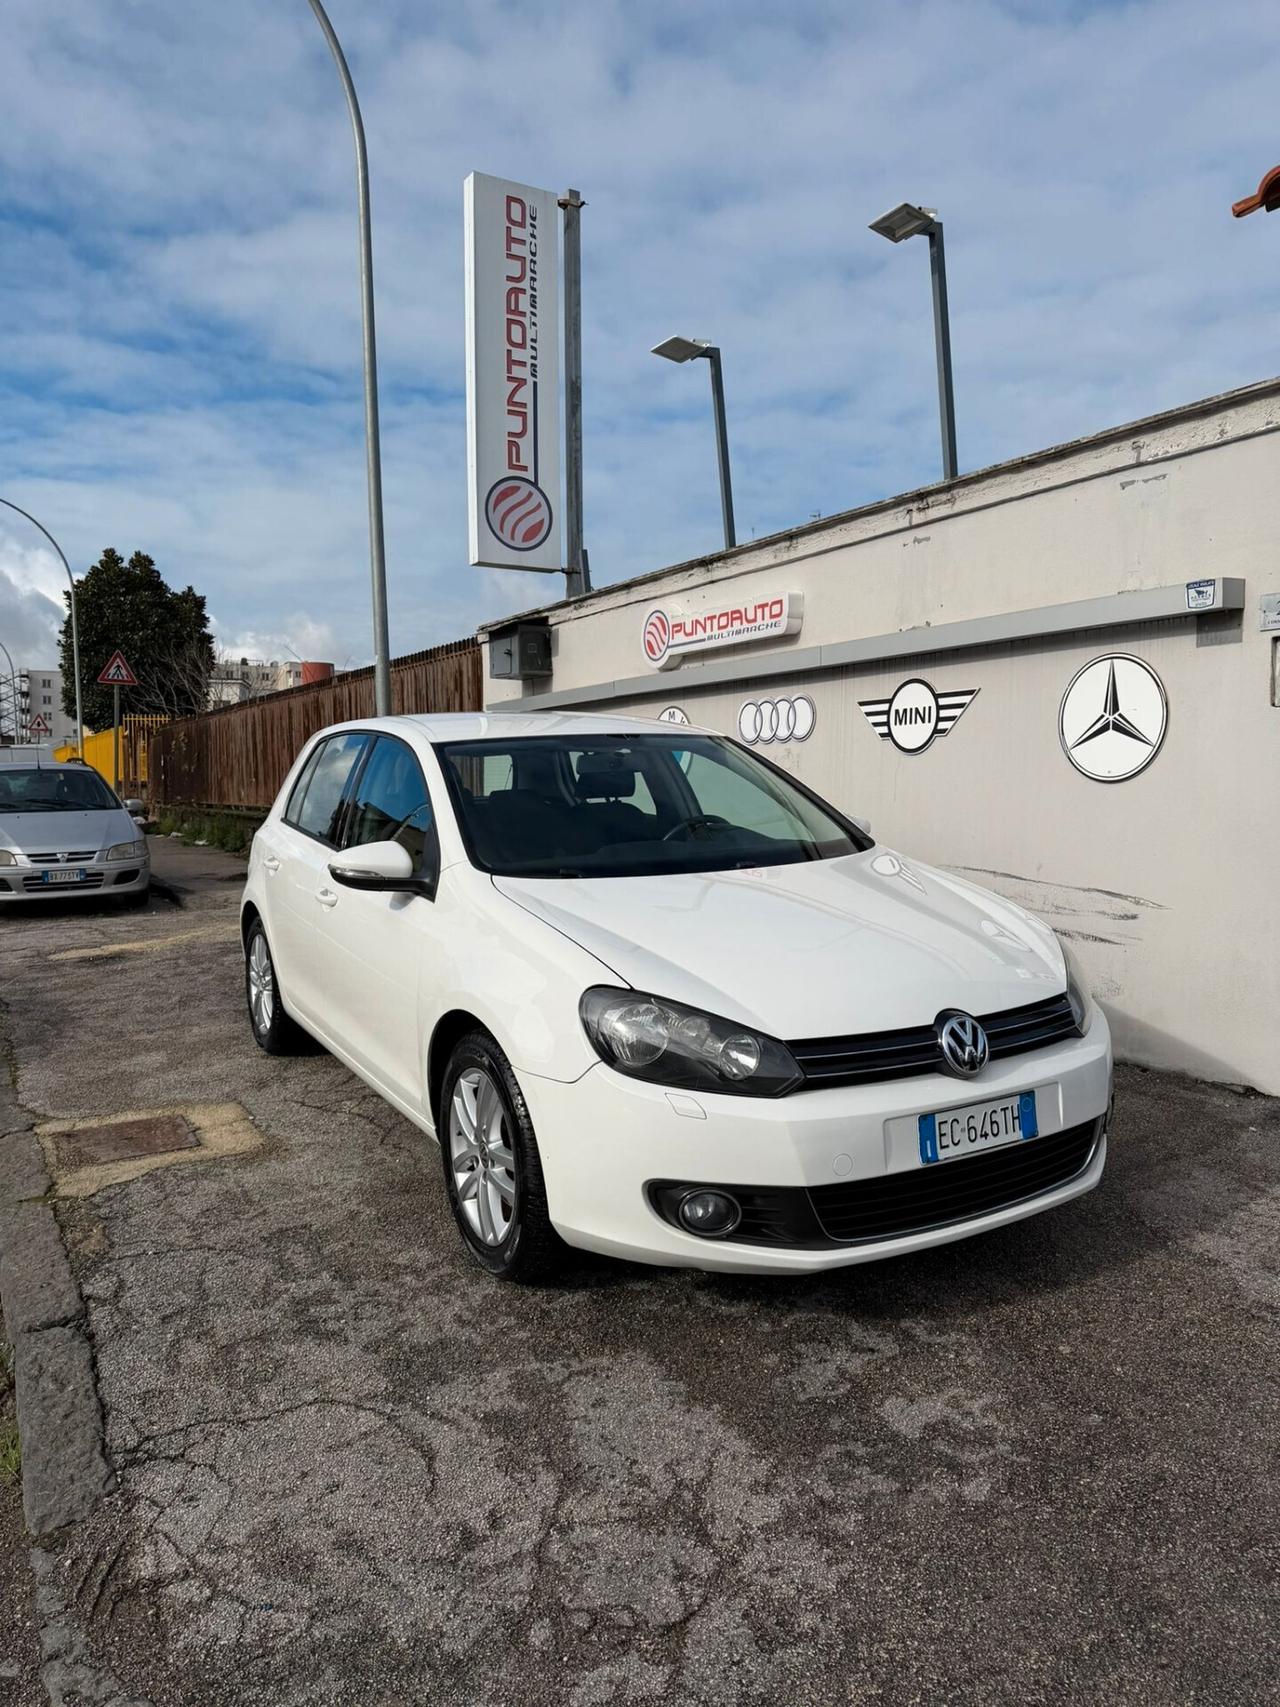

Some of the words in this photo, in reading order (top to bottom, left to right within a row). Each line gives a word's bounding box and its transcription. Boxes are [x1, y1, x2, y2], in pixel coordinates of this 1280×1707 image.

[529, 204, 539, 380] MULTIMARCHE
[505, 194, 528, 471] PUNTOAUTO
[671, 598, 784, 640] PUNTOAUTO
[706, 621, 782, 641] MULTIMARCHE
[893, 705, 932, 727] MINI
